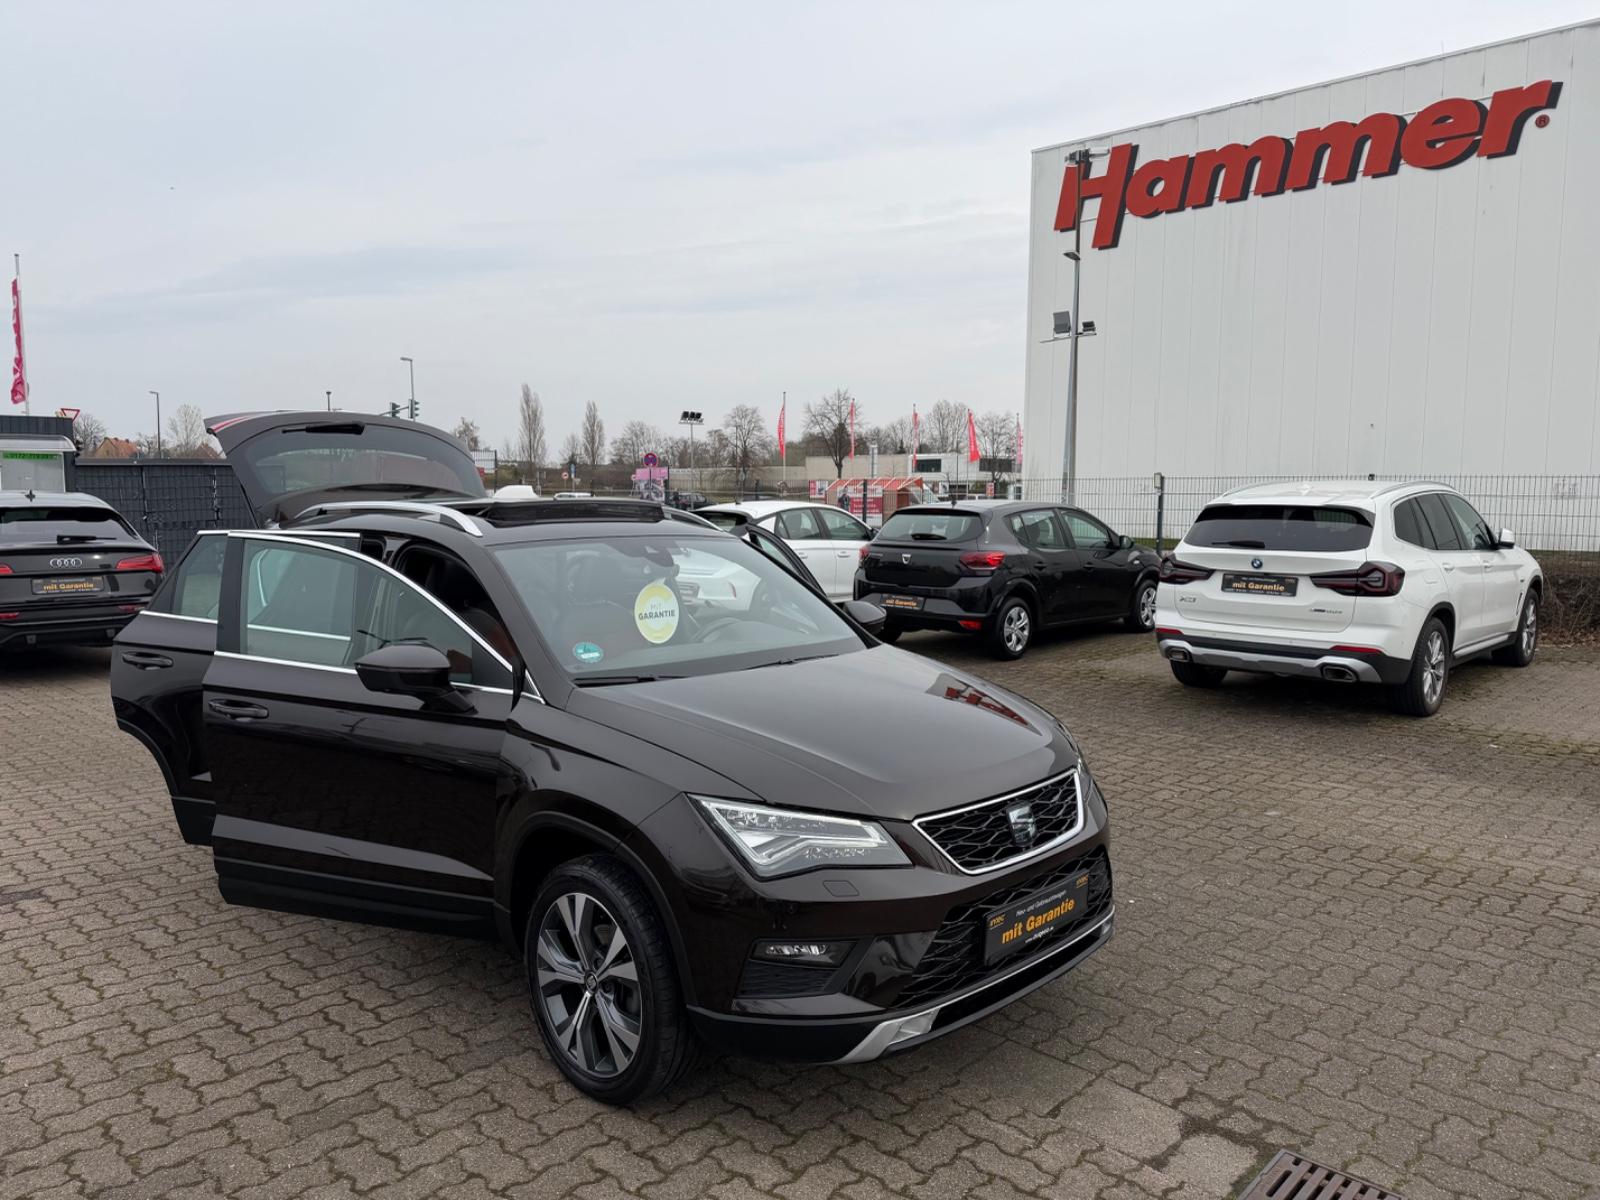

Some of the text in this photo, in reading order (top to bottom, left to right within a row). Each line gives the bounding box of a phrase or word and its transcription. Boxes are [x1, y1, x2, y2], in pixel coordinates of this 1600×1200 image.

[1053, 80, 1562, 250] Hammer
[1248, 582, 1285, 592] Garantie
[638, 609, 676, 621] GARANTIE
[1001, 921, 1024, 944] mit
[1026, 898, 1075, 932] Garantie
